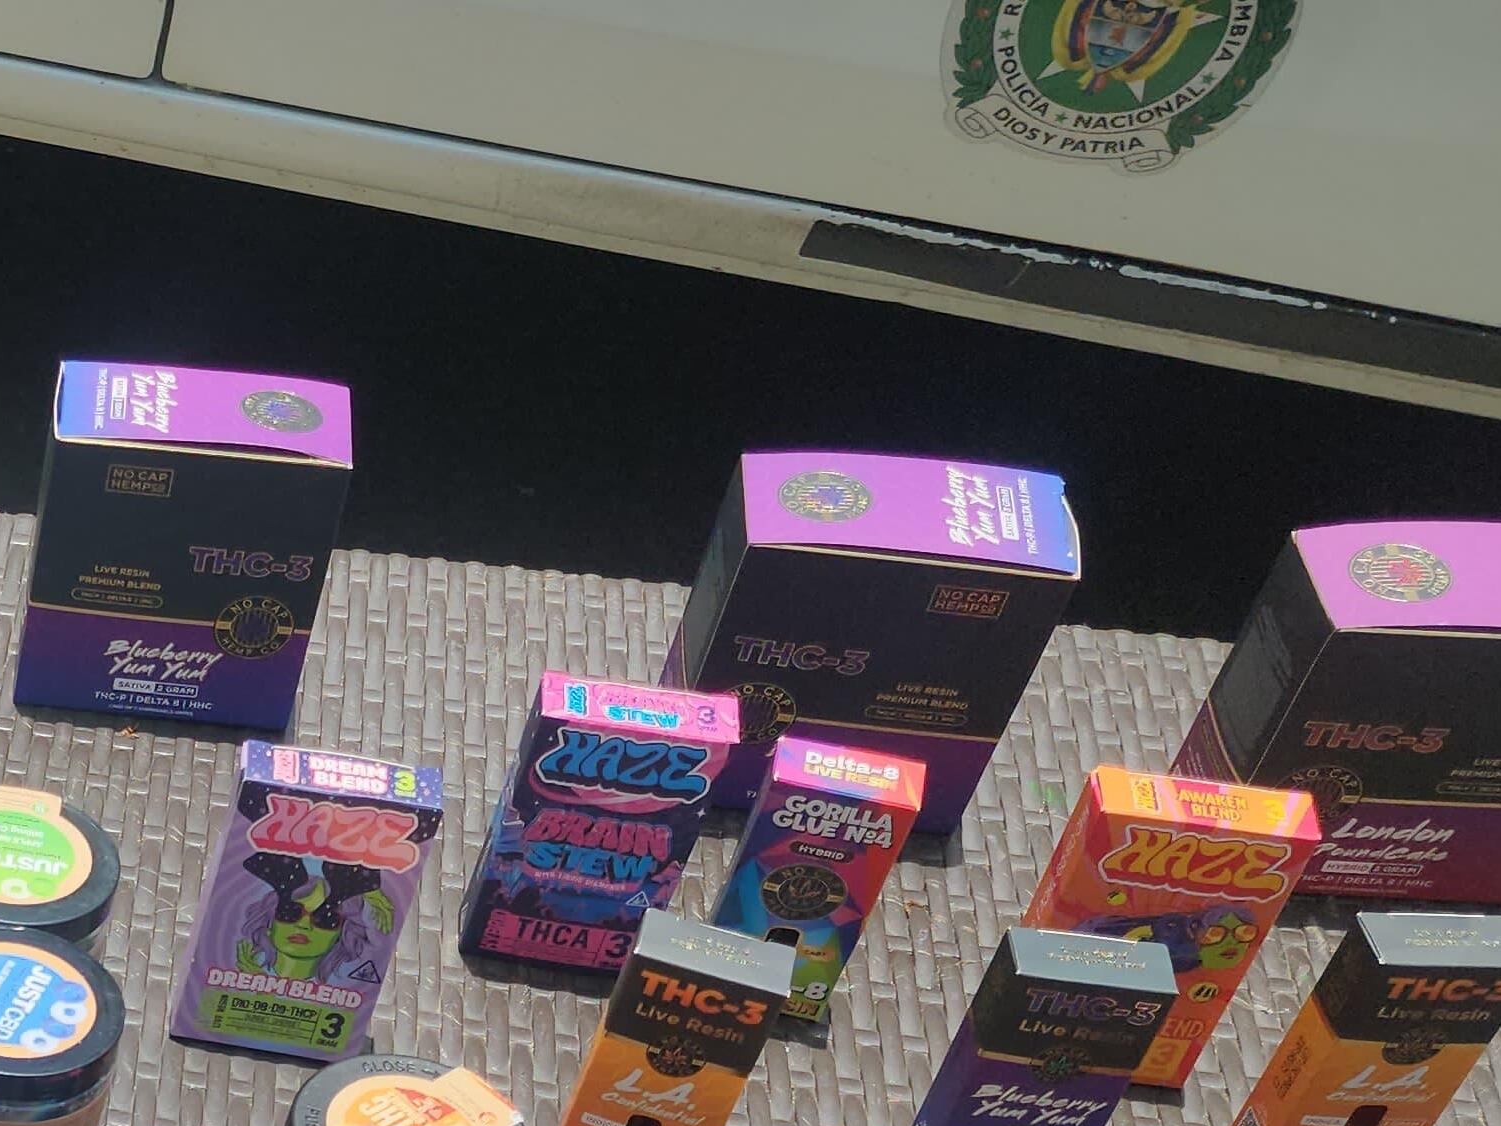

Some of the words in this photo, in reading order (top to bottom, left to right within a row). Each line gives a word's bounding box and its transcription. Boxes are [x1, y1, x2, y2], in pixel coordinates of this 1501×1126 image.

[1215, 0, 1253, 61] MBIA
[1072, 83, 1205, 130] NACIONAL
[1059, 134, 1146, 154] PATRIA
[153, 369, 179, 434] Blueberry
[112, 467, 136, 480] NO
[138, 470, 169, 483] CAP
[940, 464, 975, 548] Blueberry
[94, 564, 118, 577] LIVE
[188, 545, 314, 583] THC-3
[78, 575, 126, 590] PREMIUM
[126, 580, 162, 593] BLEND
[938, 588, 965, 602] NO
[965, 590, 1002, 605] CAP
[229, 598, 254, 615] NO
[260, 598, 288, 619] CAP
[103, 639, 225, 666] Blueberry
[734, 635, 870, 676] THC-3
[108, 655, 154, 675] Yum
[158, 659, 210, 682] Yum
[135, 694, 172, 706] DELTA
[165, 685, 196, 697] GRAM
[697, 705, 717, 724] 3
[1304, 720, 1451, 753] THC-3
[308, 753, 388, 779] DREAM
[539, 729, 709, 802] HAZE
[803, 764, 844, 780] LIVE
[844, 770, 898, 792] RESIN
[805, 751, 901, 781] Delta-8
[312, 770, 388, 795] BLEND
[393, 770, 417, 797] 3
[785, 795, 892, 831] GORILLA
[1178, 789, 1248, 812] AWAKEN
[1189, 803, 1242, 822] BLEND
[250, 796, 419, 873] HAZE
[523, 810, 672, 861] BRAIN
[772, 811, 839, 838] GLUE
[1331, 818, 1456, 844] London
[525, 841, 656, 882] STEW
[798, 844, 845, 862] HYBRID
[1100, 826, 1290, 902] HAZE
[515, 918, 590, 949] THCA
[607, 933, 632, 960] 3
[207, 968, 288, 997] DREAM
[288, 979, 363, 1010] BLEND
[641, 970, 769, 1026] THC-3
[1026, 987, 1163, 1027] THC-3
[320, 1012, 346, 1039] 3
[634, 1001, 682, 1025] Live
[685, 1016, 746, 1043] Resin
[1019, 1018, 1065, 1036] Live
[360, 1060, 417, 1075] CLOSE
[613, 1068, 698, 1110] L.A.
[969, 1084, 1108, 1116] Blueberry
[971, 1099, 1022, 1122] Yum
